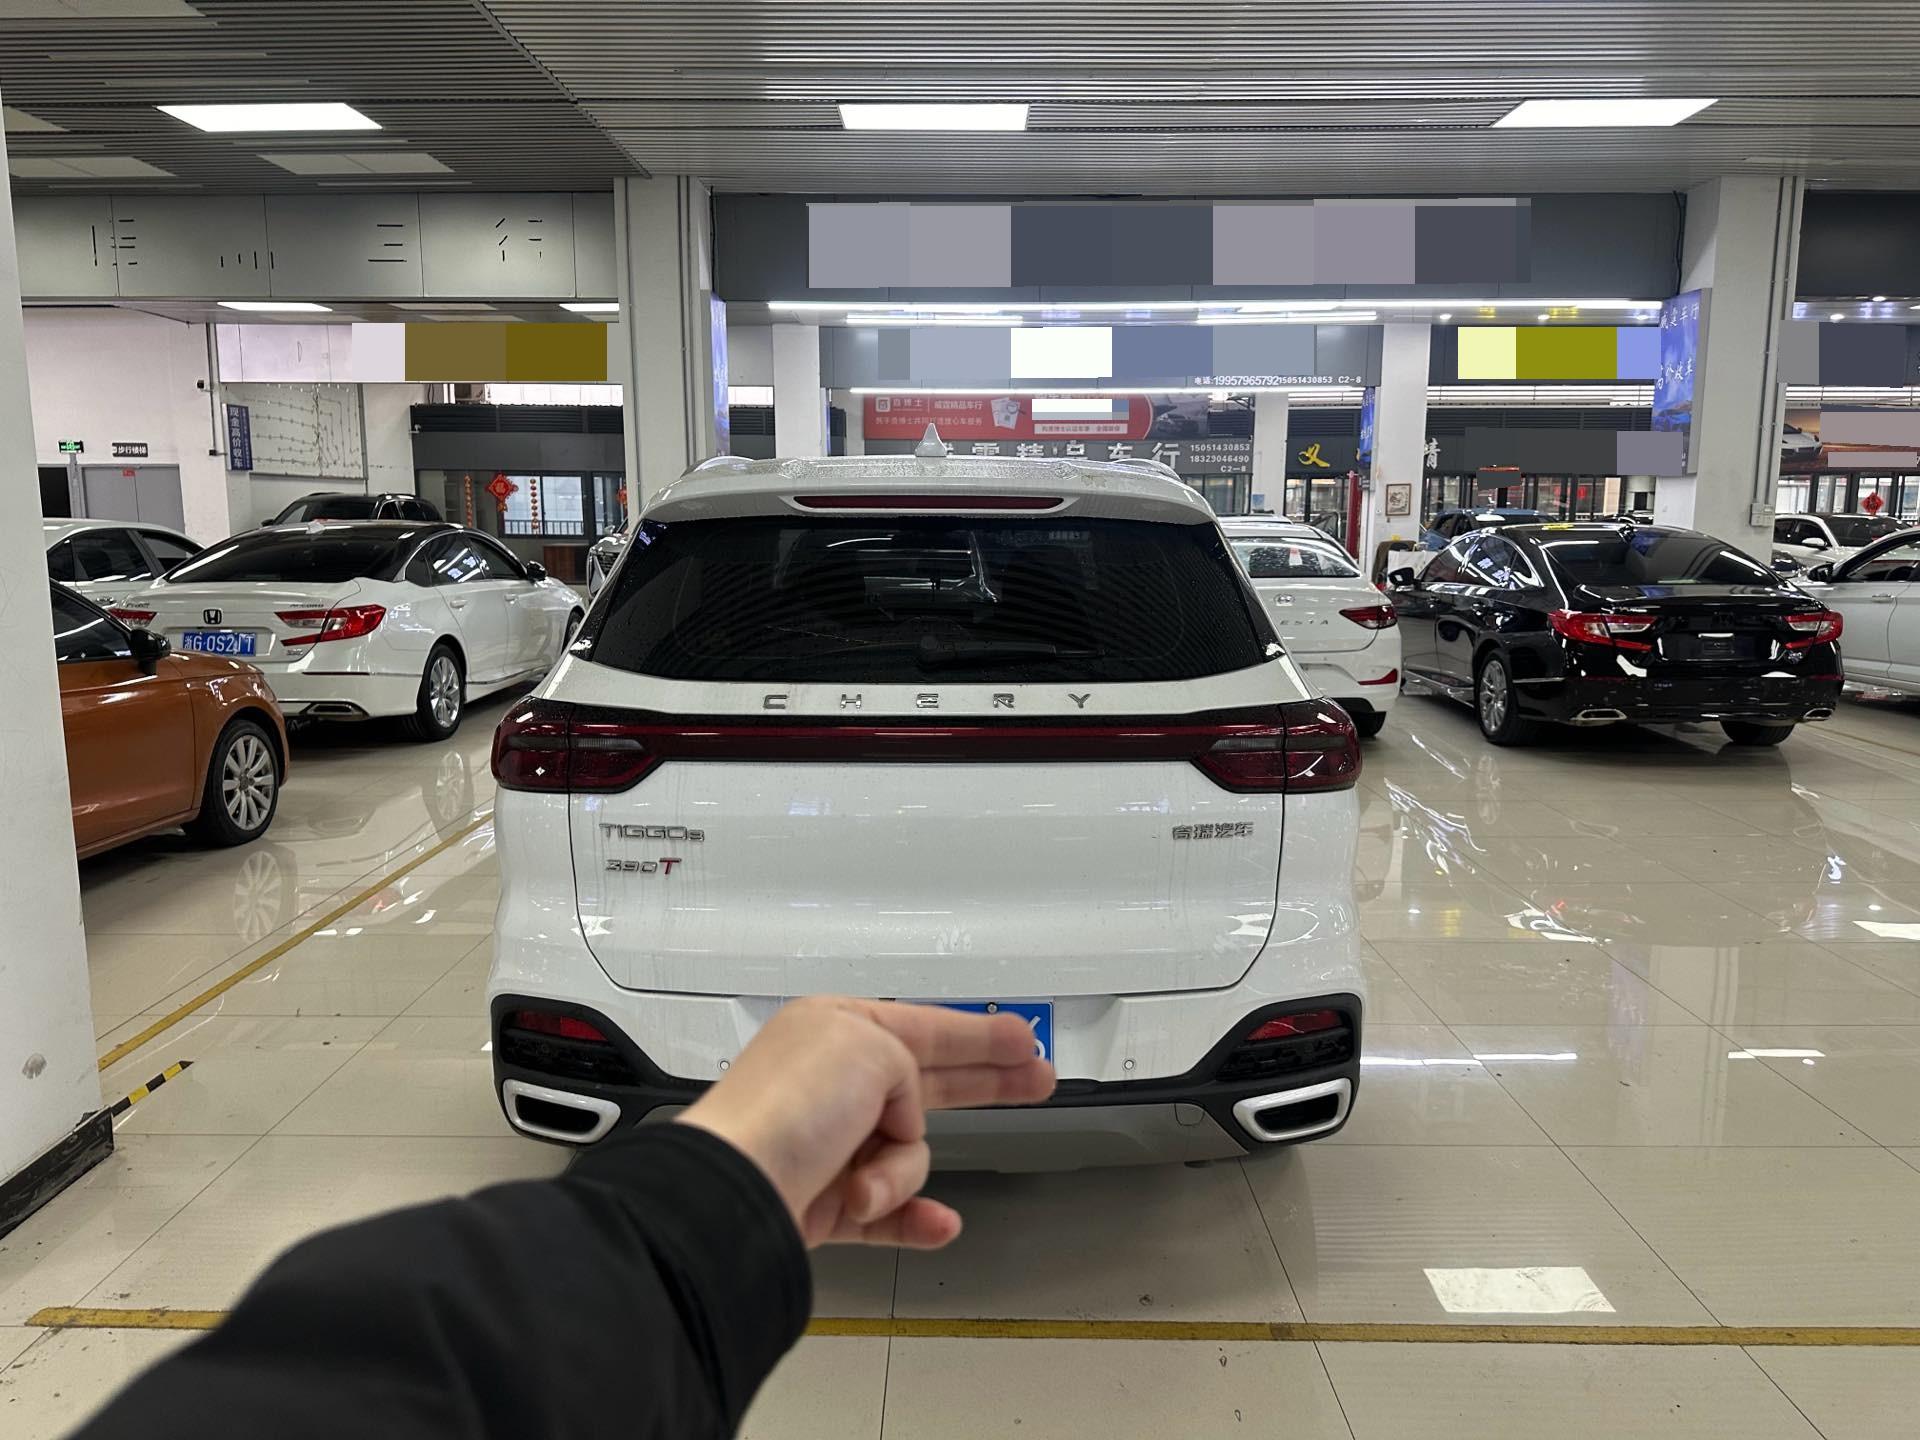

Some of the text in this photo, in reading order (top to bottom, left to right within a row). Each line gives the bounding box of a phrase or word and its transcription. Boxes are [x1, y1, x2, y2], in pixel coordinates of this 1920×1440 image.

[1338, 376, 1362, 384] C2-8
[229, 407, 243, 468] 现金高价收车
[763, 693, 1091, 709] CHERY
[1172, 821, 1254, 840] 奇瑞汽车
[606, 858, 682, 875] 390T
